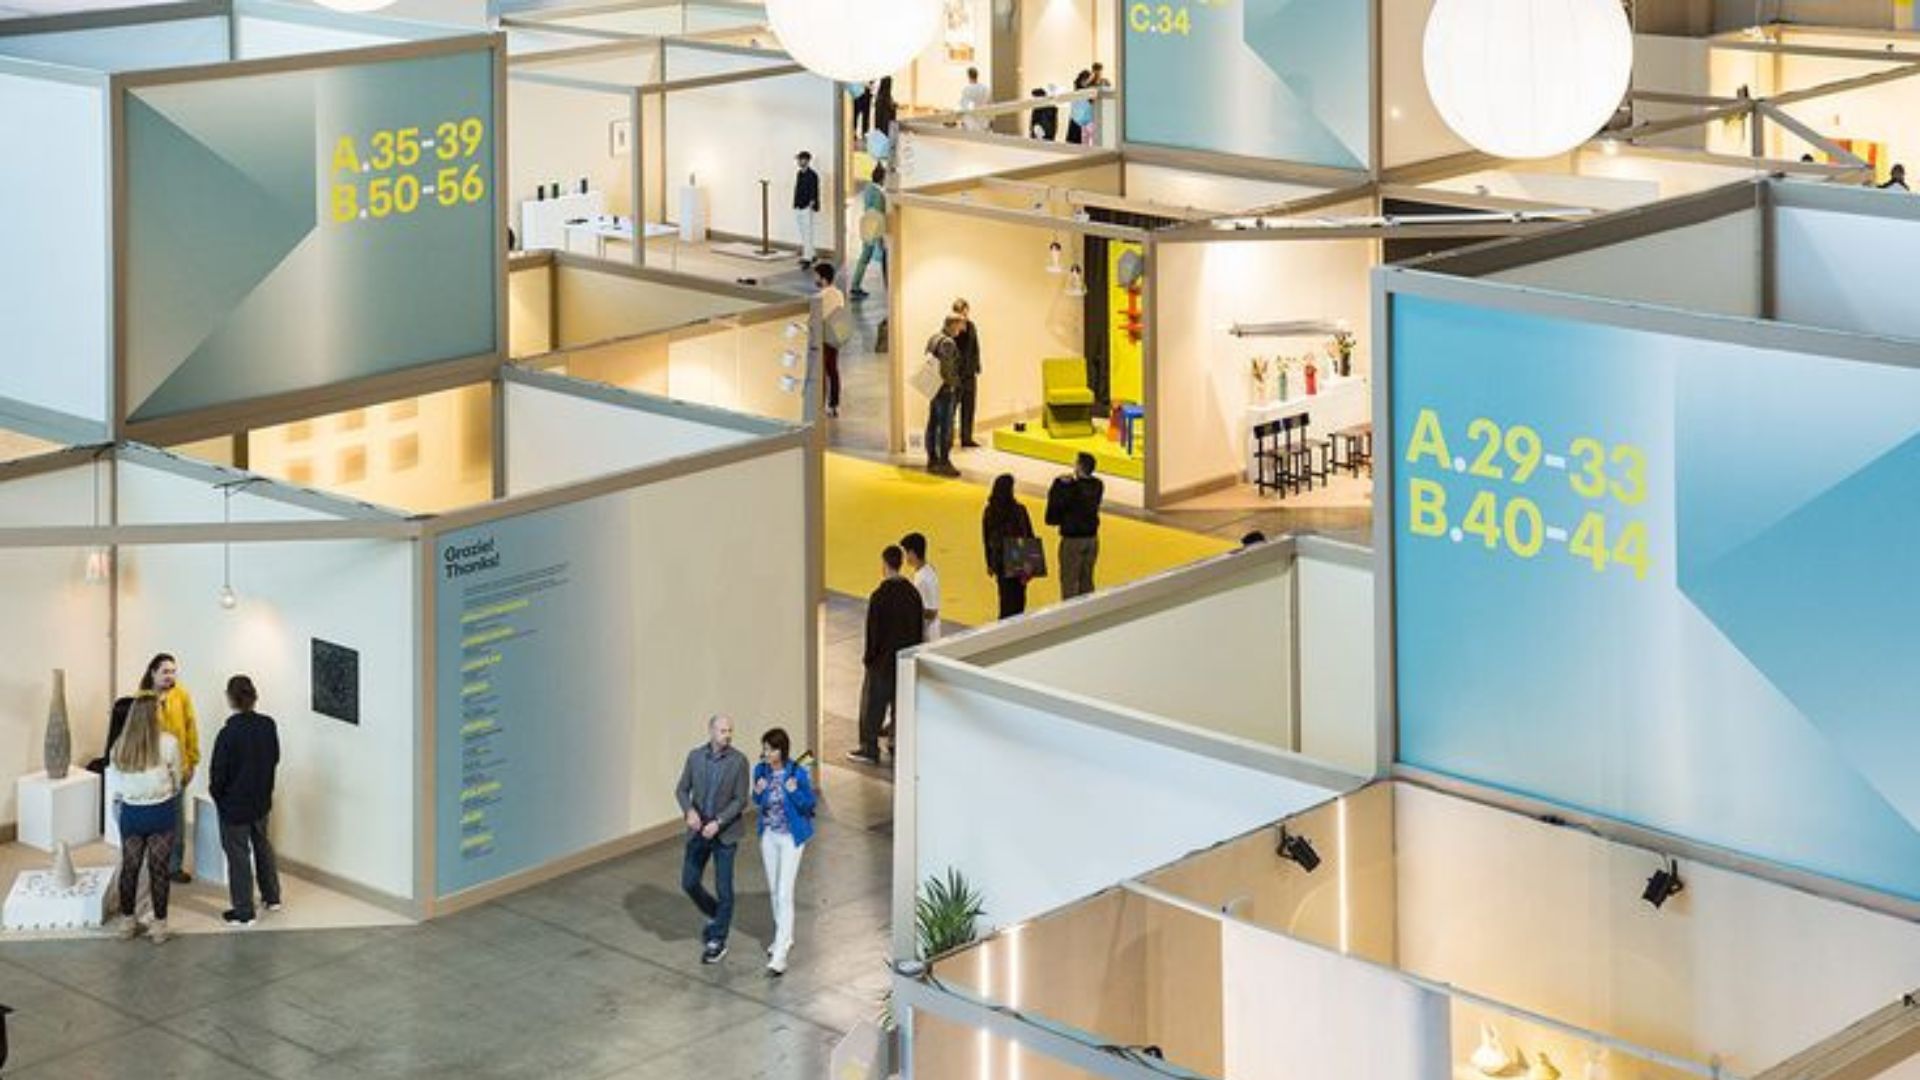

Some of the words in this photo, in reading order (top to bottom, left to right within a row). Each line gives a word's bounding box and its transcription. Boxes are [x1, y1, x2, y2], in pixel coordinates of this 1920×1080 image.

[1129, 3, 1190, 36] C.34
[331, 117, 484, 176] A.35-39
[332, 163, 484, 222] B.50-56
[1405, 408, 1647, 505] A.29-33
[444, 536, 495, 562] Grazie!
[1409, 477, 1653, 581] B.40-44
[445, 551, 500, 578] Thanks!
